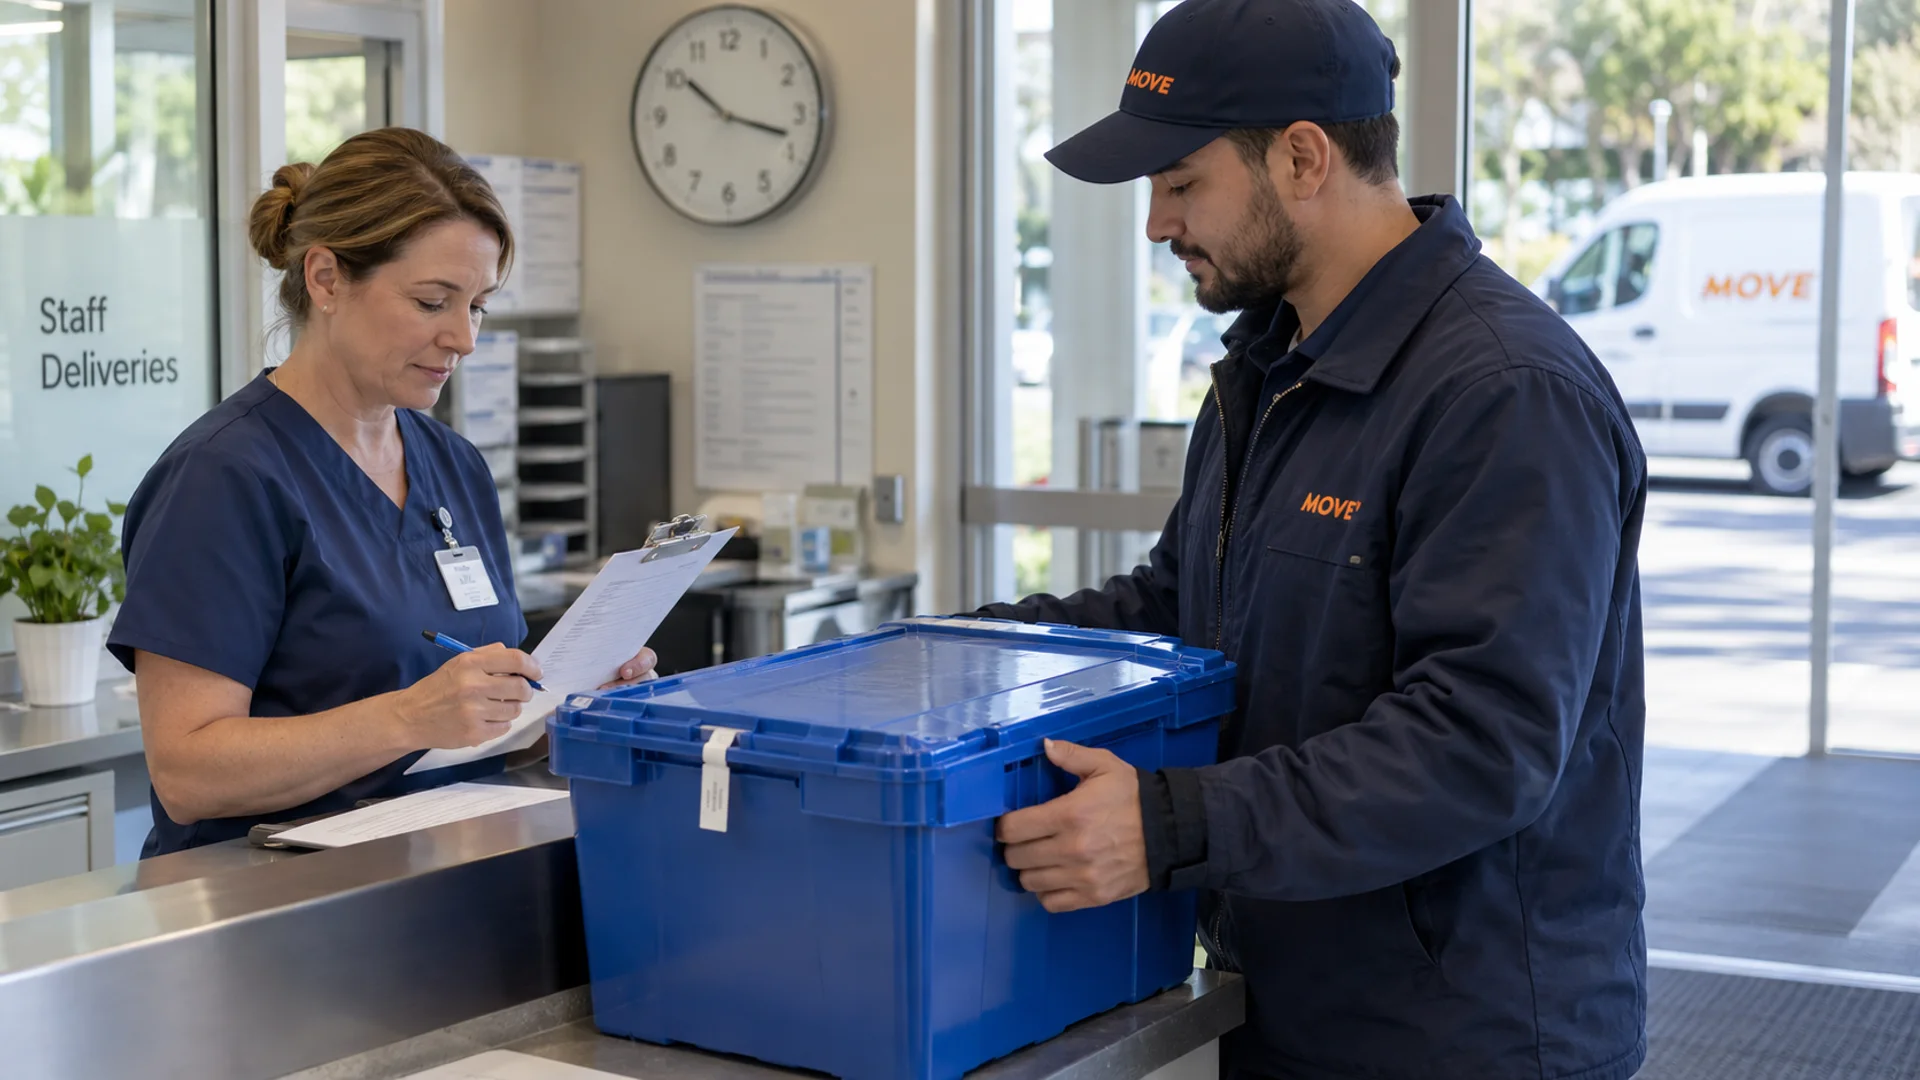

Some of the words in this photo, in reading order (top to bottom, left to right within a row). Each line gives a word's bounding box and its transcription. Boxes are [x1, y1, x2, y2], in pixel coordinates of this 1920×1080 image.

[689, 40, 706, 62] 11
[719, 28, 741, 51] 12
[759, 38, 768, 59] 1
[665, 68, 687, 90] 10
[780, 63, 795, 87] 2
[1126, 67, 1175, 95] MOVE
[653, 105, 668, 128] 9
[793, 102, 807, 126] 3
[663, 143, 677, 168] 8
[689, 169, 702, 192] 7
[757, 169, 771, 193] 5
[721, 182, 736, 205] 6
[1702, 271, 1814, 300] MOVE
[40, 296, 107, 335] Staff
[41, 350, 179, 390] Deliveries
